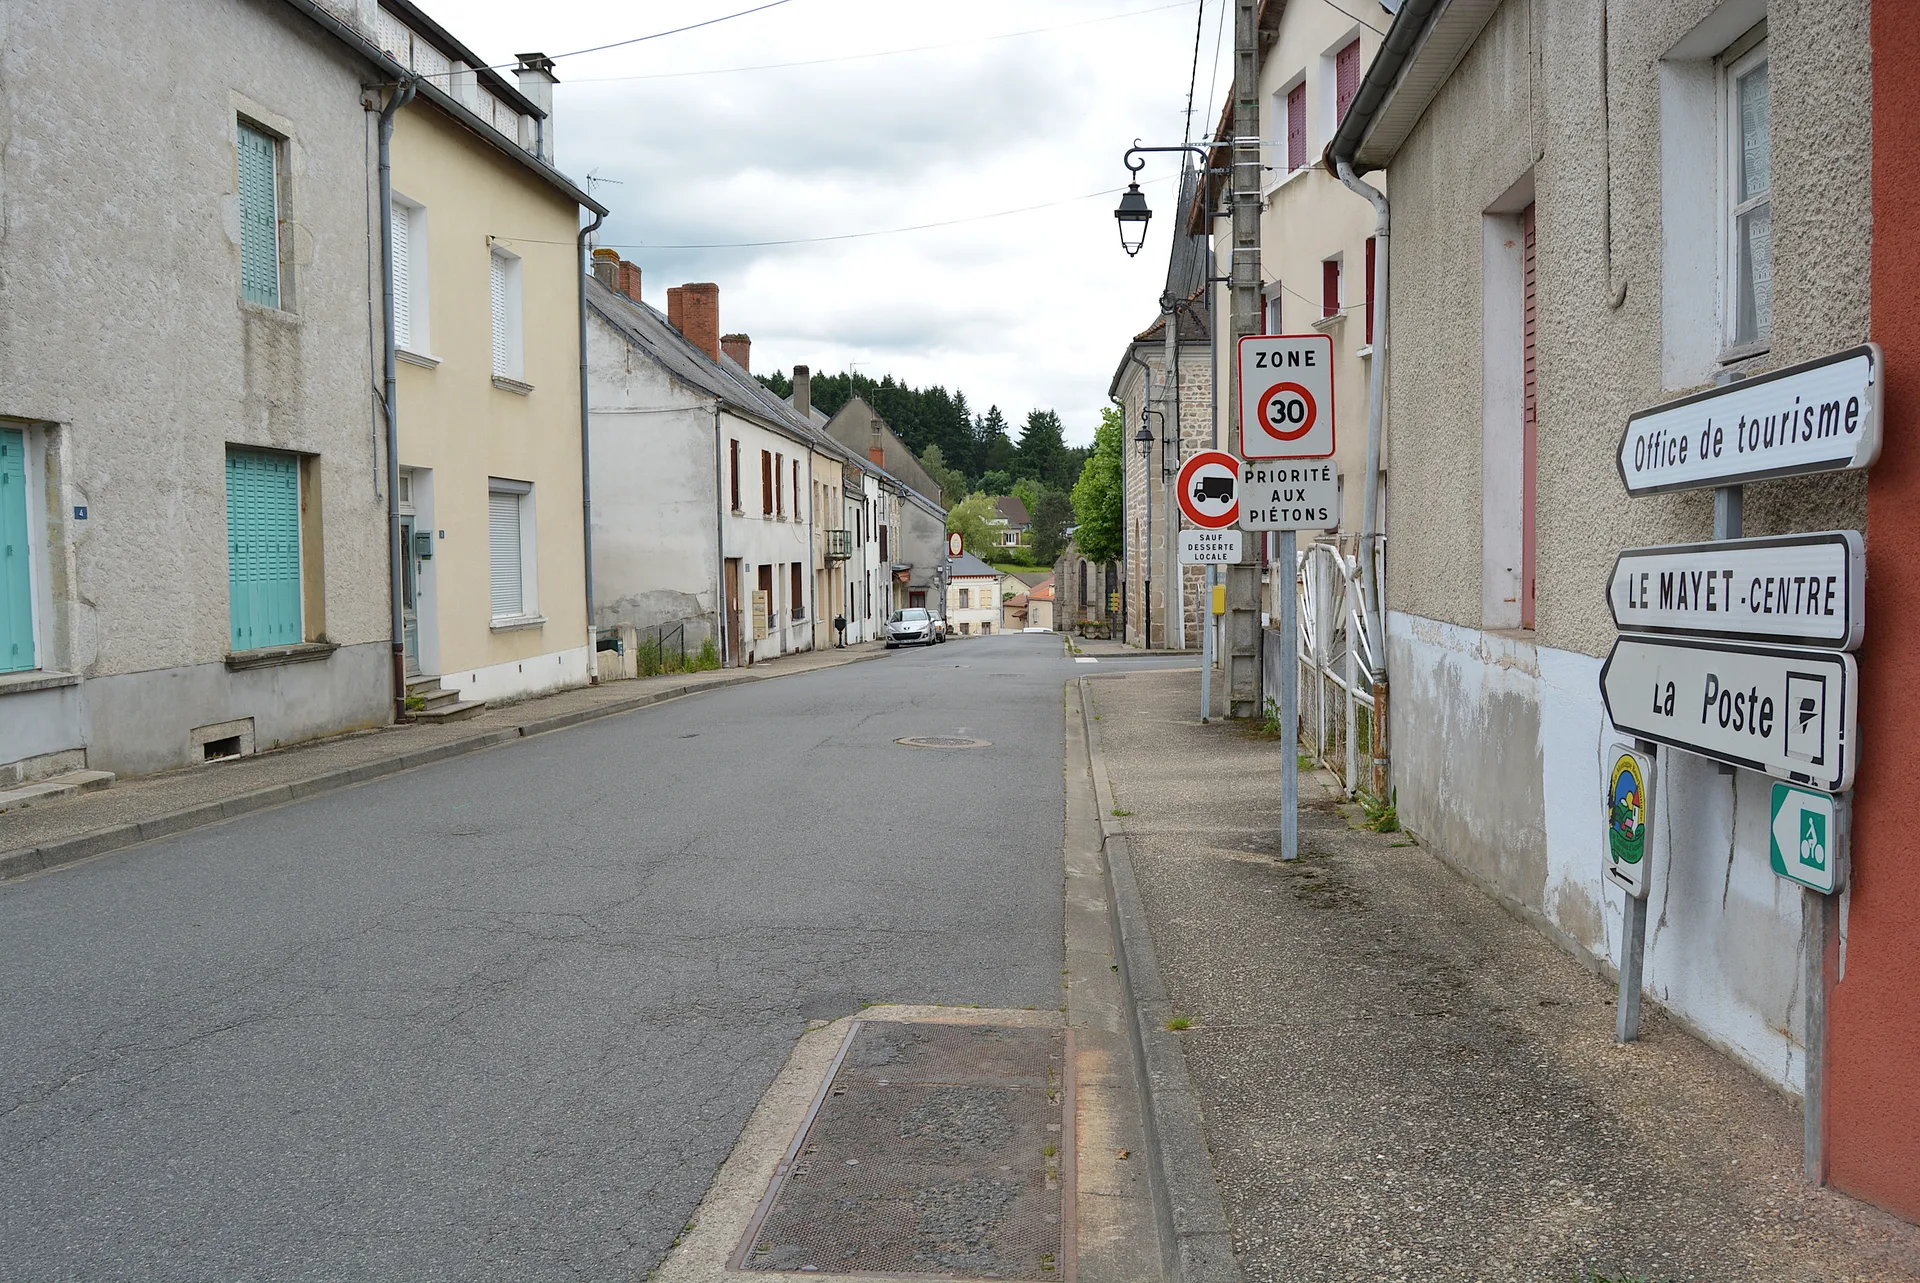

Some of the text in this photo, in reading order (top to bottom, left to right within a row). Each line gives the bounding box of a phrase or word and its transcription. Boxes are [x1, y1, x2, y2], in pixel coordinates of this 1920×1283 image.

[1255, 350, 1316, 369] ZONE
[1270, 399, 1305, 424] 30
[1634, 396, 1859, 472] Office de tourisme
[1245, 465, 1331, 484] PRIORITÉ
[1271, 488, 1306, 502] AUX
[1250, 506, 1328, 523] PIÉTONS
[1187, 543, 1234, 551] DESSERTE
[1199, 534, 1223, 542] SAUF
[1194, 553, 1228, 561] LOCALE
[1629, 572, 1649, 609] LE
[1659, 569, 1734, 612] MAYET
[1652, 673, 1774, 738] La Poste
